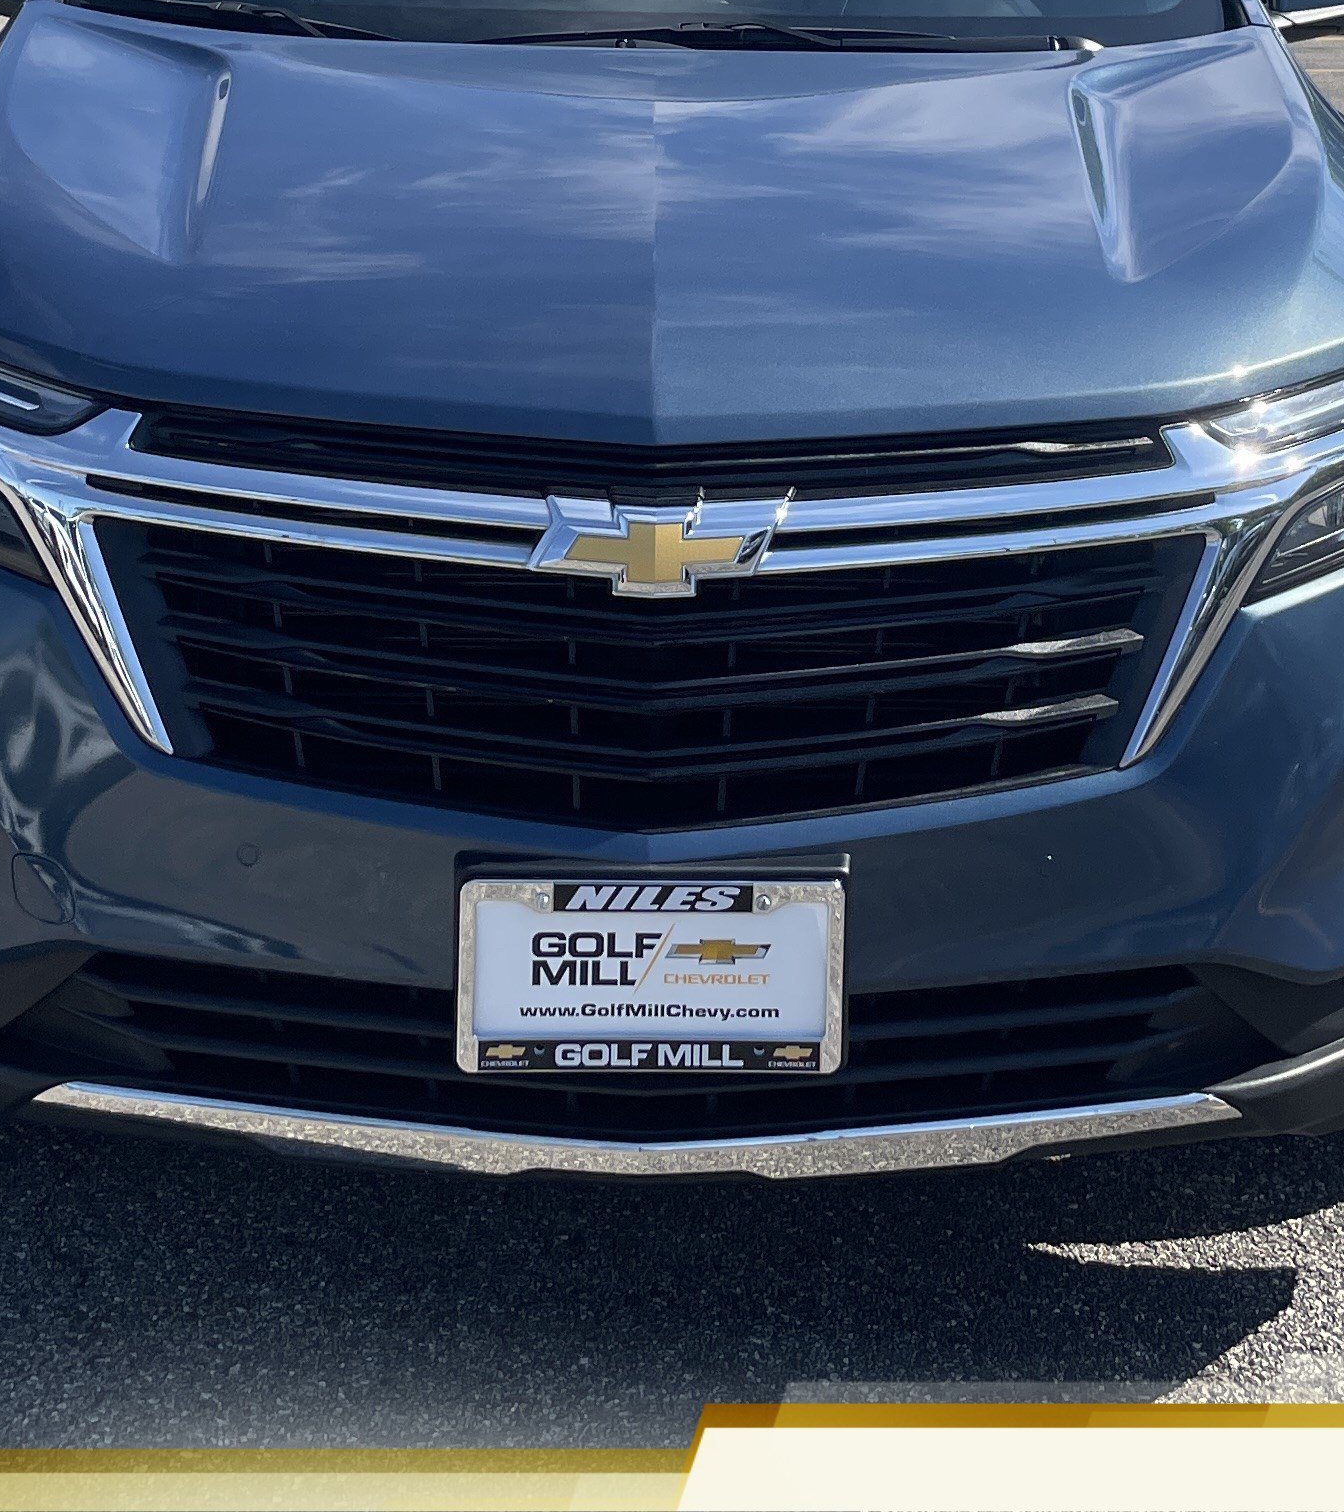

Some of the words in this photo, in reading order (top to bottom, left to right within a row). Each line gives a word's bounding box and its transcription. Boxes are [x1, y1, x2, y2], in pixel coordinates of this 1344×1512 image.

[565, 886, 741, 911] NILES
[532, 932, 663, 958] GOLF
[532, 960, 637, 986] MILL
[663, 973, 770, 985] CHEVROLET
[520, 1003, 780, 1021] www.GolfMillChevy.com
[554, 1043, 653, 1067] GOLF
[657, 1043, 746, 1067] MILL
